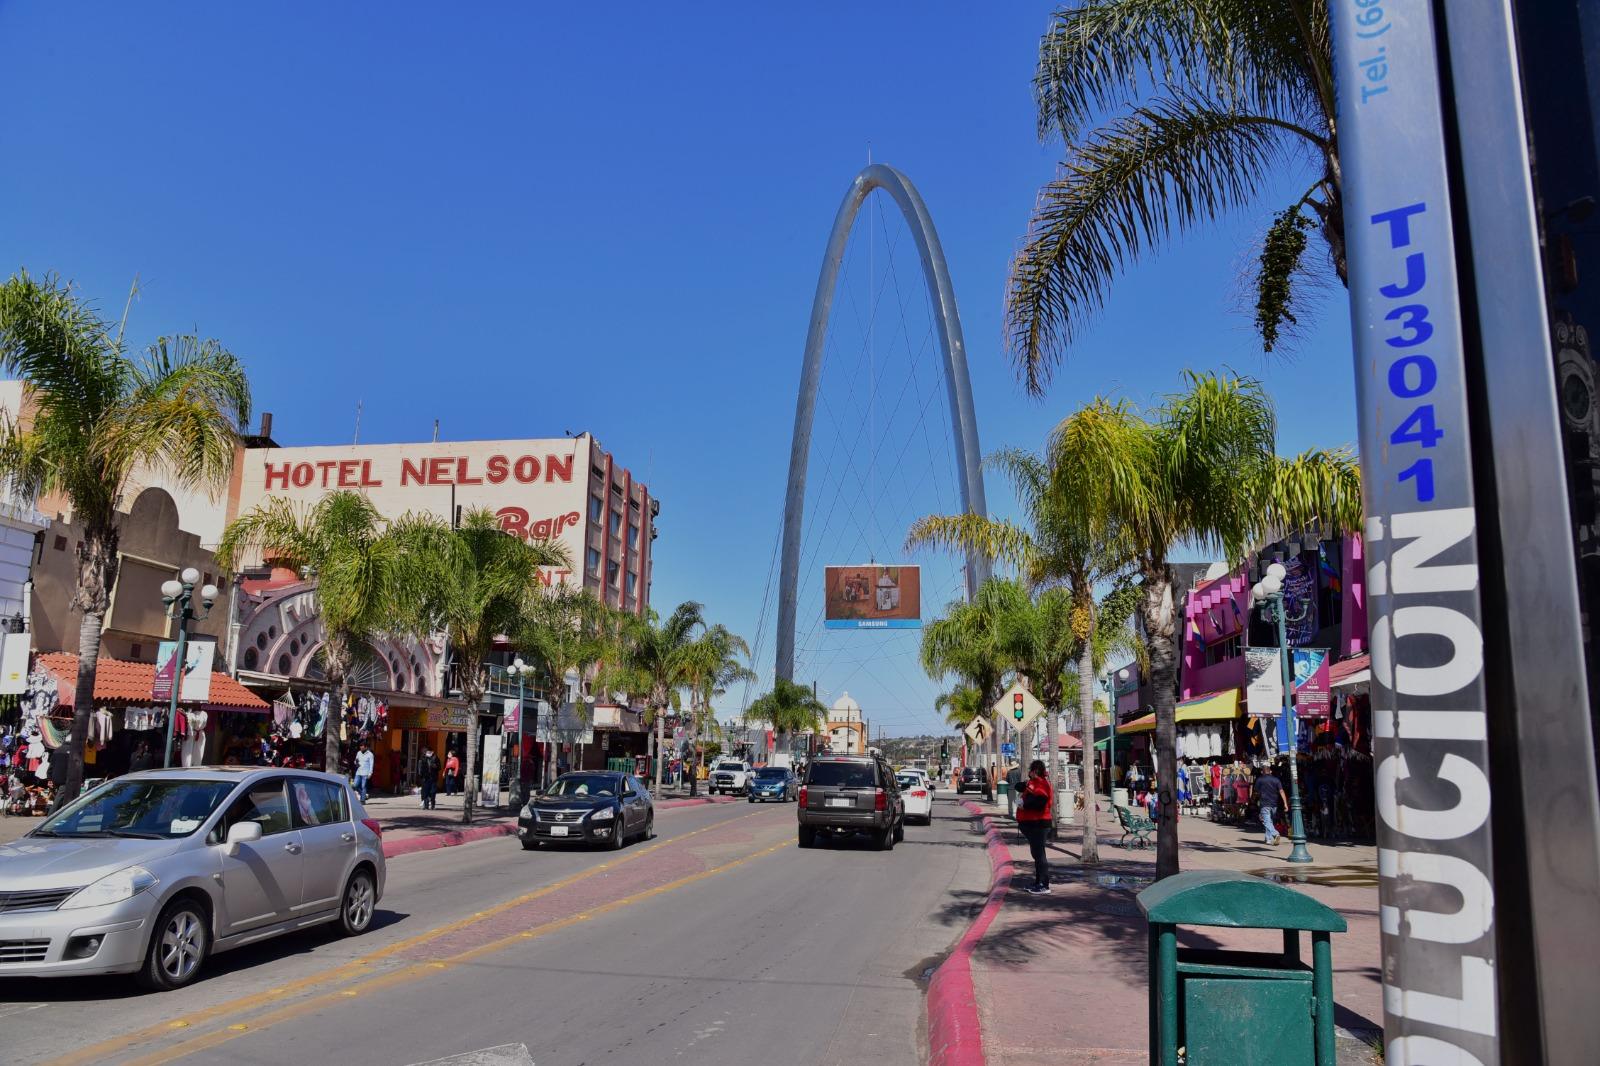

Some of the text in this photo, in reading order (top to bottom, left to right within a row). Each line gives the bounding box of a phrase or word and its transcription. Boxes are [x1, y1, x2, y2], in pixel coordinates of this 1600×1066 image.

[1358, 46, 1389, 105] Tel.
[1370, 201, 1445, 503] TJ3041
[264, 454, 574, 490] HOTEL NELSON
[495, 506, 580, 541] Bar
